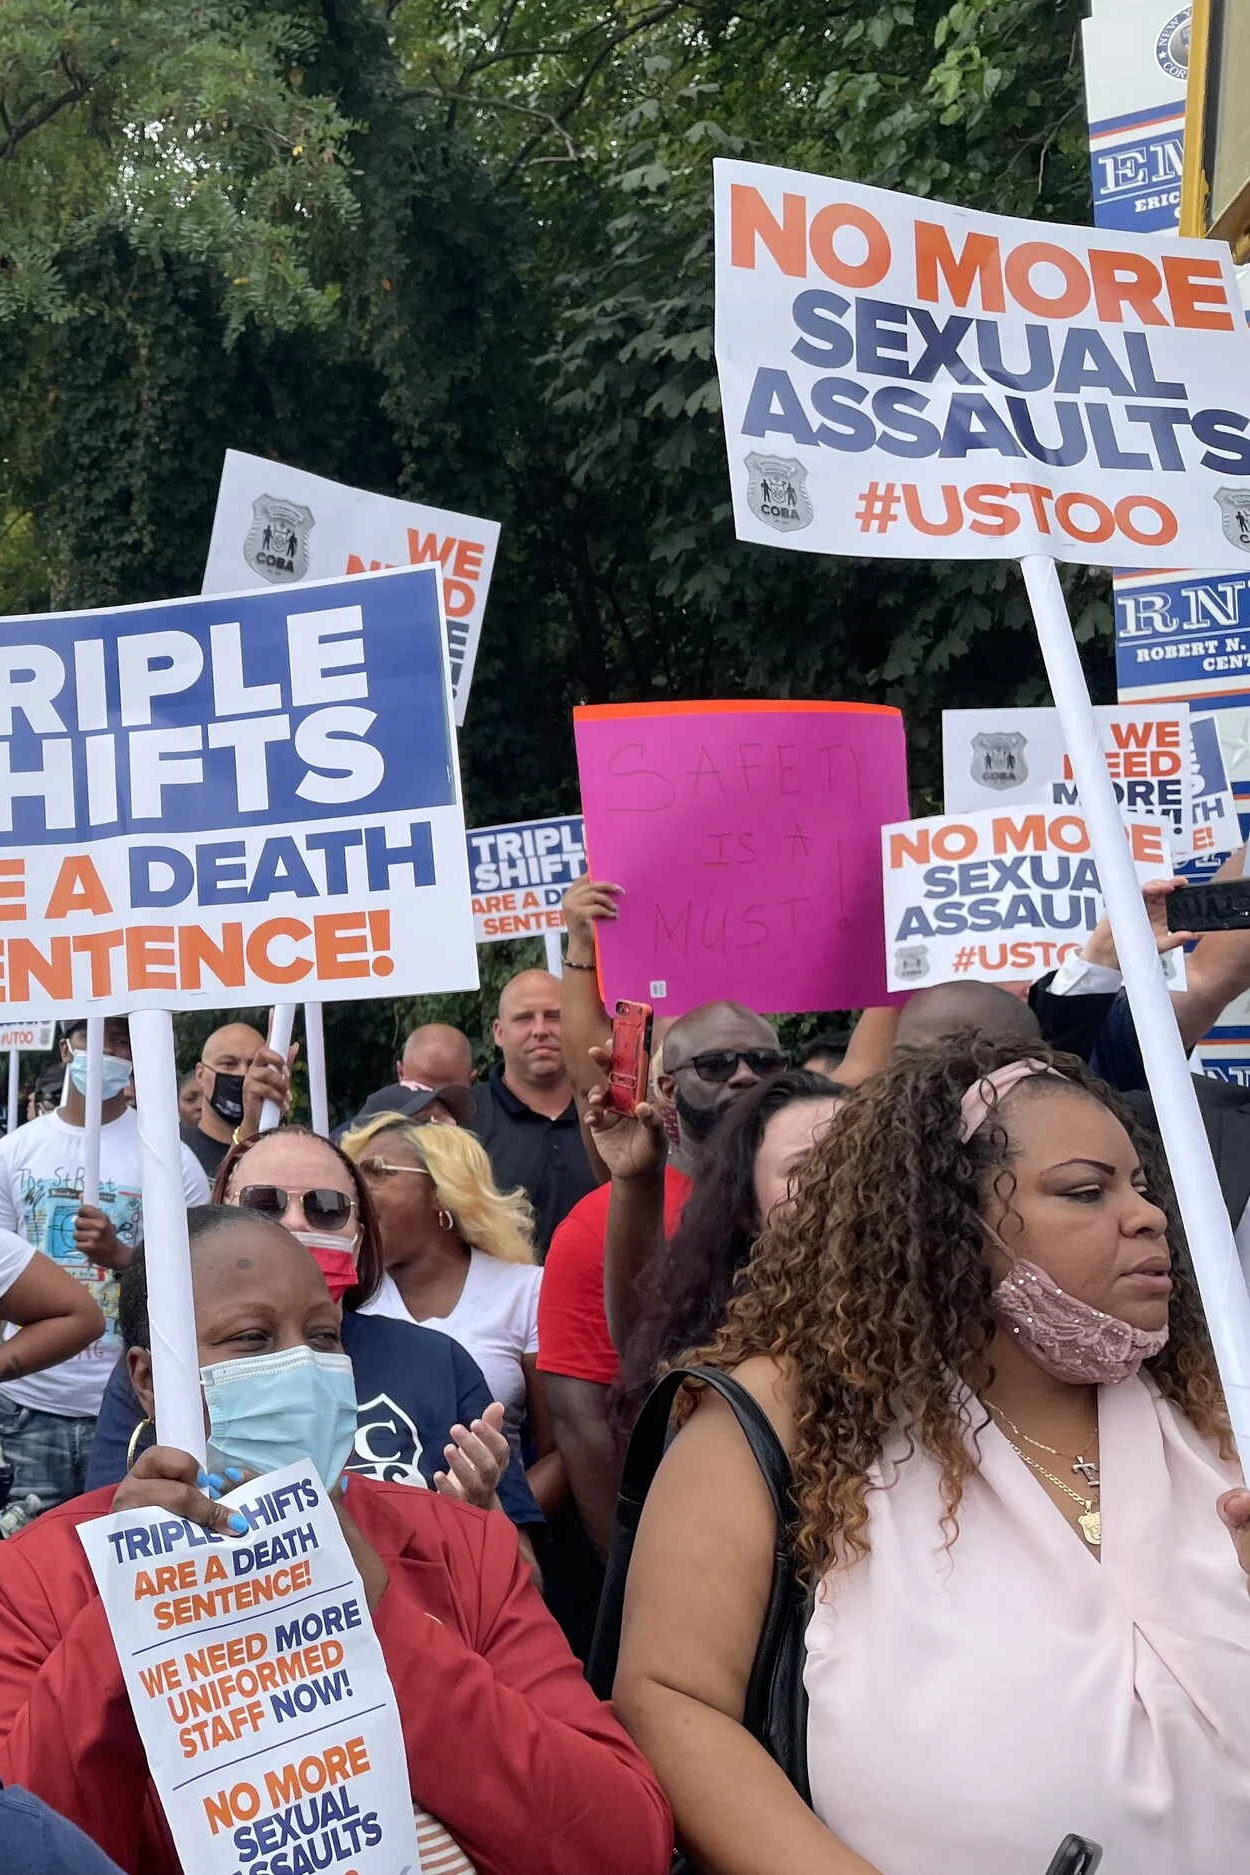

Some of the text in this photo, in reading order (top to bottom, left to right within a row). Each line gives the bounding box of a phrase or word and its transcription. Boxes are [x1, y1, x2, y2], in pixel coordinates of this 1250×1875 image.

[1134, 191, 1180, 213] ERIC
[730, 184, 1234, 332] NO MORE
[791, 289, 1187, 400] SEXUAL
[741, 367, 1250, 476] ASSAULTS
[761, 504, 800, 521] COBA
[855, 481, 1178, 546] #USTOO
[256, 552, 295, 573] COBA
[406, 528, 486, 581] WE
[1117, 580, 1250, 638] RN
[1136, 637, 1246, 662] ROBERT N.
[1110, 721, 1180, 749] WE
[607, 743, 862, 812] SAFETY
[44, 855, 113, 921] A
[128, 821, 437, 909] DEATH
[702, 822, 811, 866] IS A
[890, 824, 978, 869] NO
[992, 815, 1164, 864] MOE
[472, 893, 517, 914] ARE
[522, 890, 540, 909] A
[18, 1168, 43, 1191] The
[233, 1478, 320, 1538] HIFTS
[134, 1522, 320, 1601] ARE A DEATH
[153, 1559, 313, 1631] SENTENCE!
[138, 1598, 362, 1699] WE NEED MORE
[167, 1639, 345, 1725] UNIFORMED
[179, 1669, 354, 1759] STAFF NOW!
[203, 1735, 371, 1835] NO MORE
[233, 1785, 360, 1863] SEXUAL
